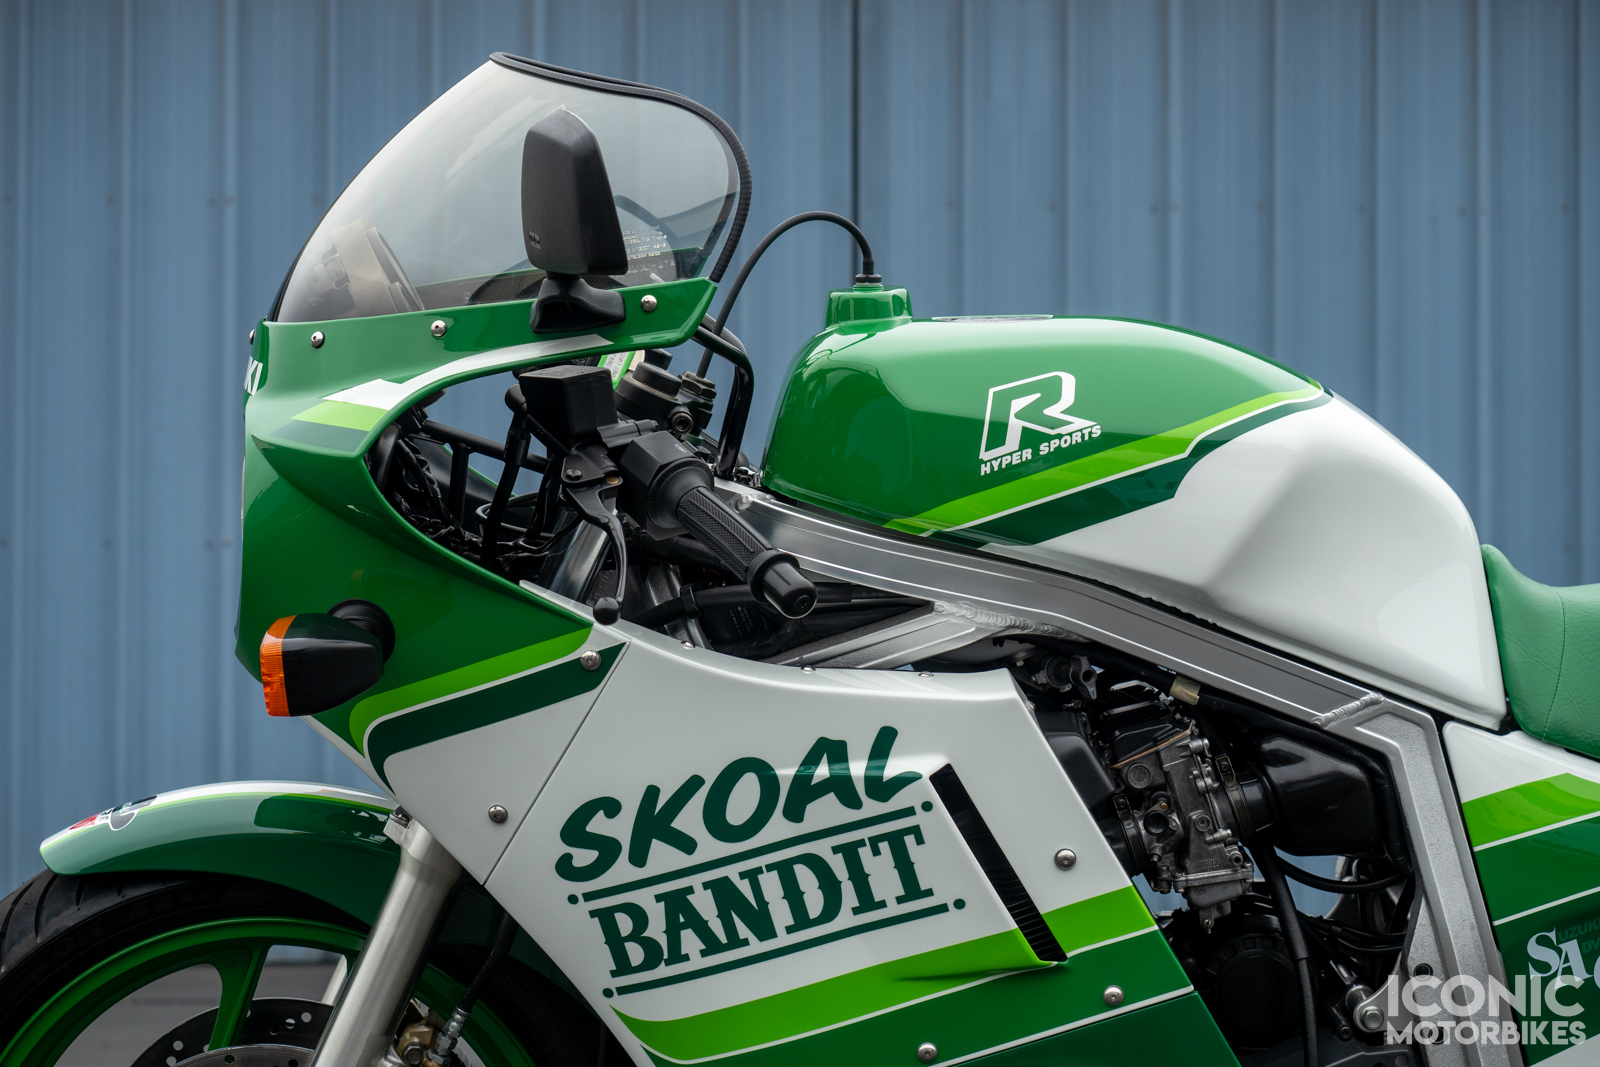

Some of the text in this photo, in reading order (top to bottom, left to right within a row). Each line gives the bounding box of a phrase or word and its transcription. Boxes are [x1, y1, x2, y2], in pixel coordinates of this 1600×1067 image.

[979, 371, 1098, 462] R
[980, 425, 1102, 476] HYPER SPORTS
[555, 725, 923, 883] SKOAL
[588, 824, 935, 979] BANDIT
